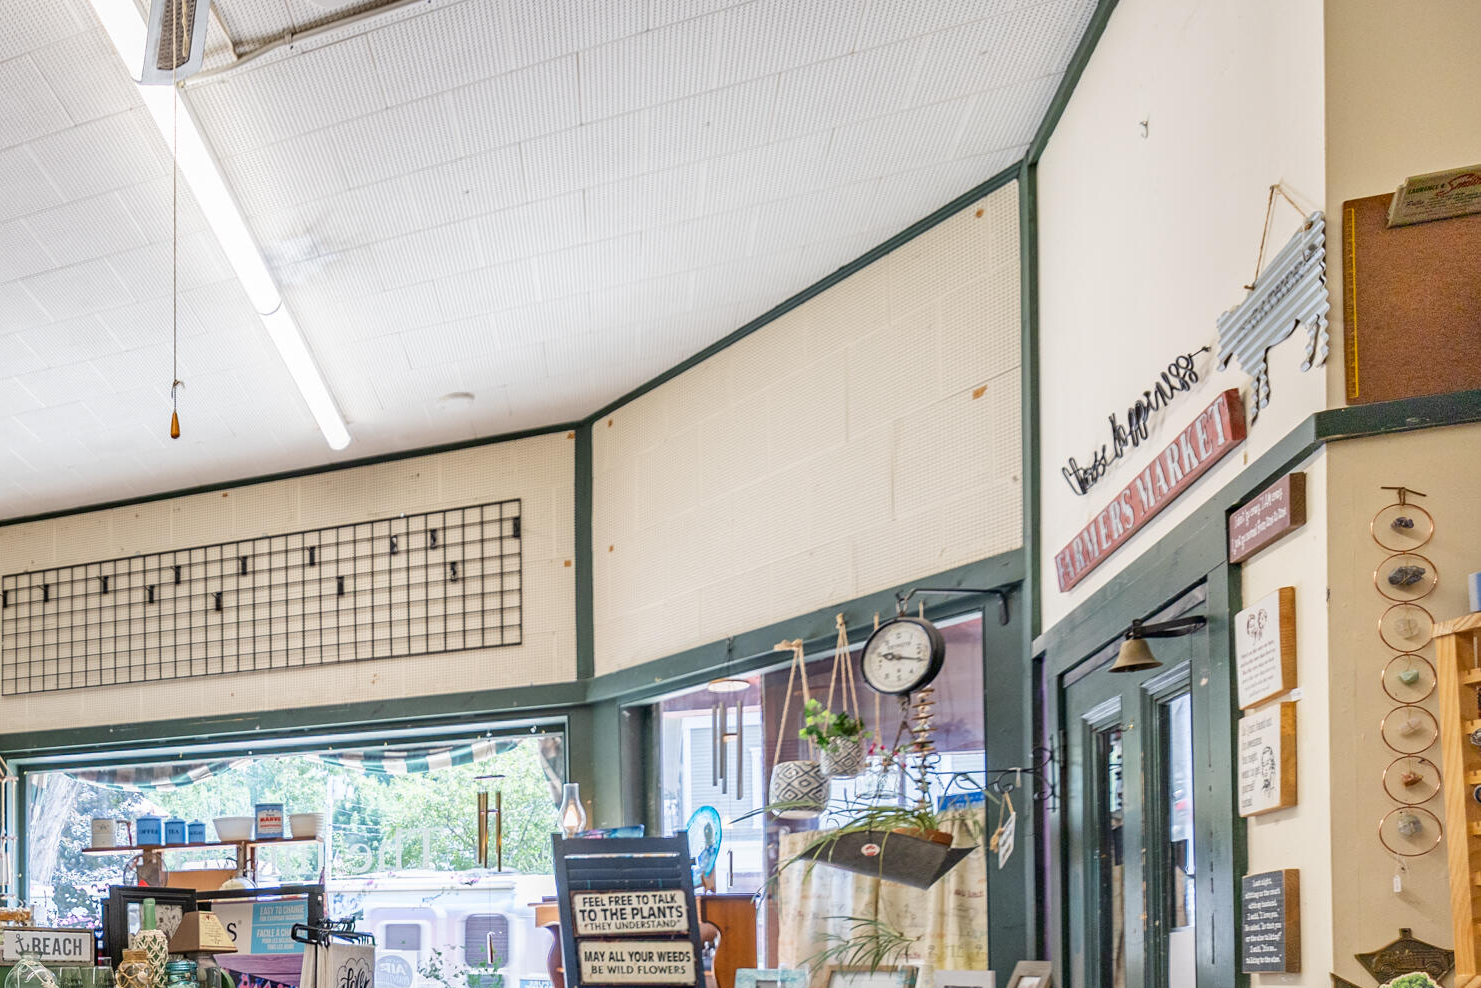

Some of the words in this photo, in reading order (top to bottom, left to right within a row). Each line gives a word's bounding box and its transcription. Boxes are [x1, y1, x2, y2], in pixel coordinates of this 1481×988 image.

[1056, 483, 1135, 588] FARMERS
[1136, 394, 1228, 521] MARKET
[583, 897, 606, 907] FEEL
[608, 896, 631, 906] FREE
[635, 895, 648, 905] TO
[651, 894, 677, 904] TALK
[260, 907, 274, 915] EASY
[275, 906, 282, 914] TO
[283, 905, 304, 913] CHANGE
[579, 909, 597, 921] TO
[602, 908, 628, 920] THE
[631, 905, 683, 919] PLANTS
[32, 934, 83, 957] BEACH
[584, 951, 605, 962] MAY
[608, 951, 625, 962] ALL
[628, 951, 654, 962] YOUR
[657, 951, 691, 962] WEEDS
[591, 965, 604, 974] BE
[606, 965, 633, 974] WILD
[637, 965, 686, 975] FLOWERS
